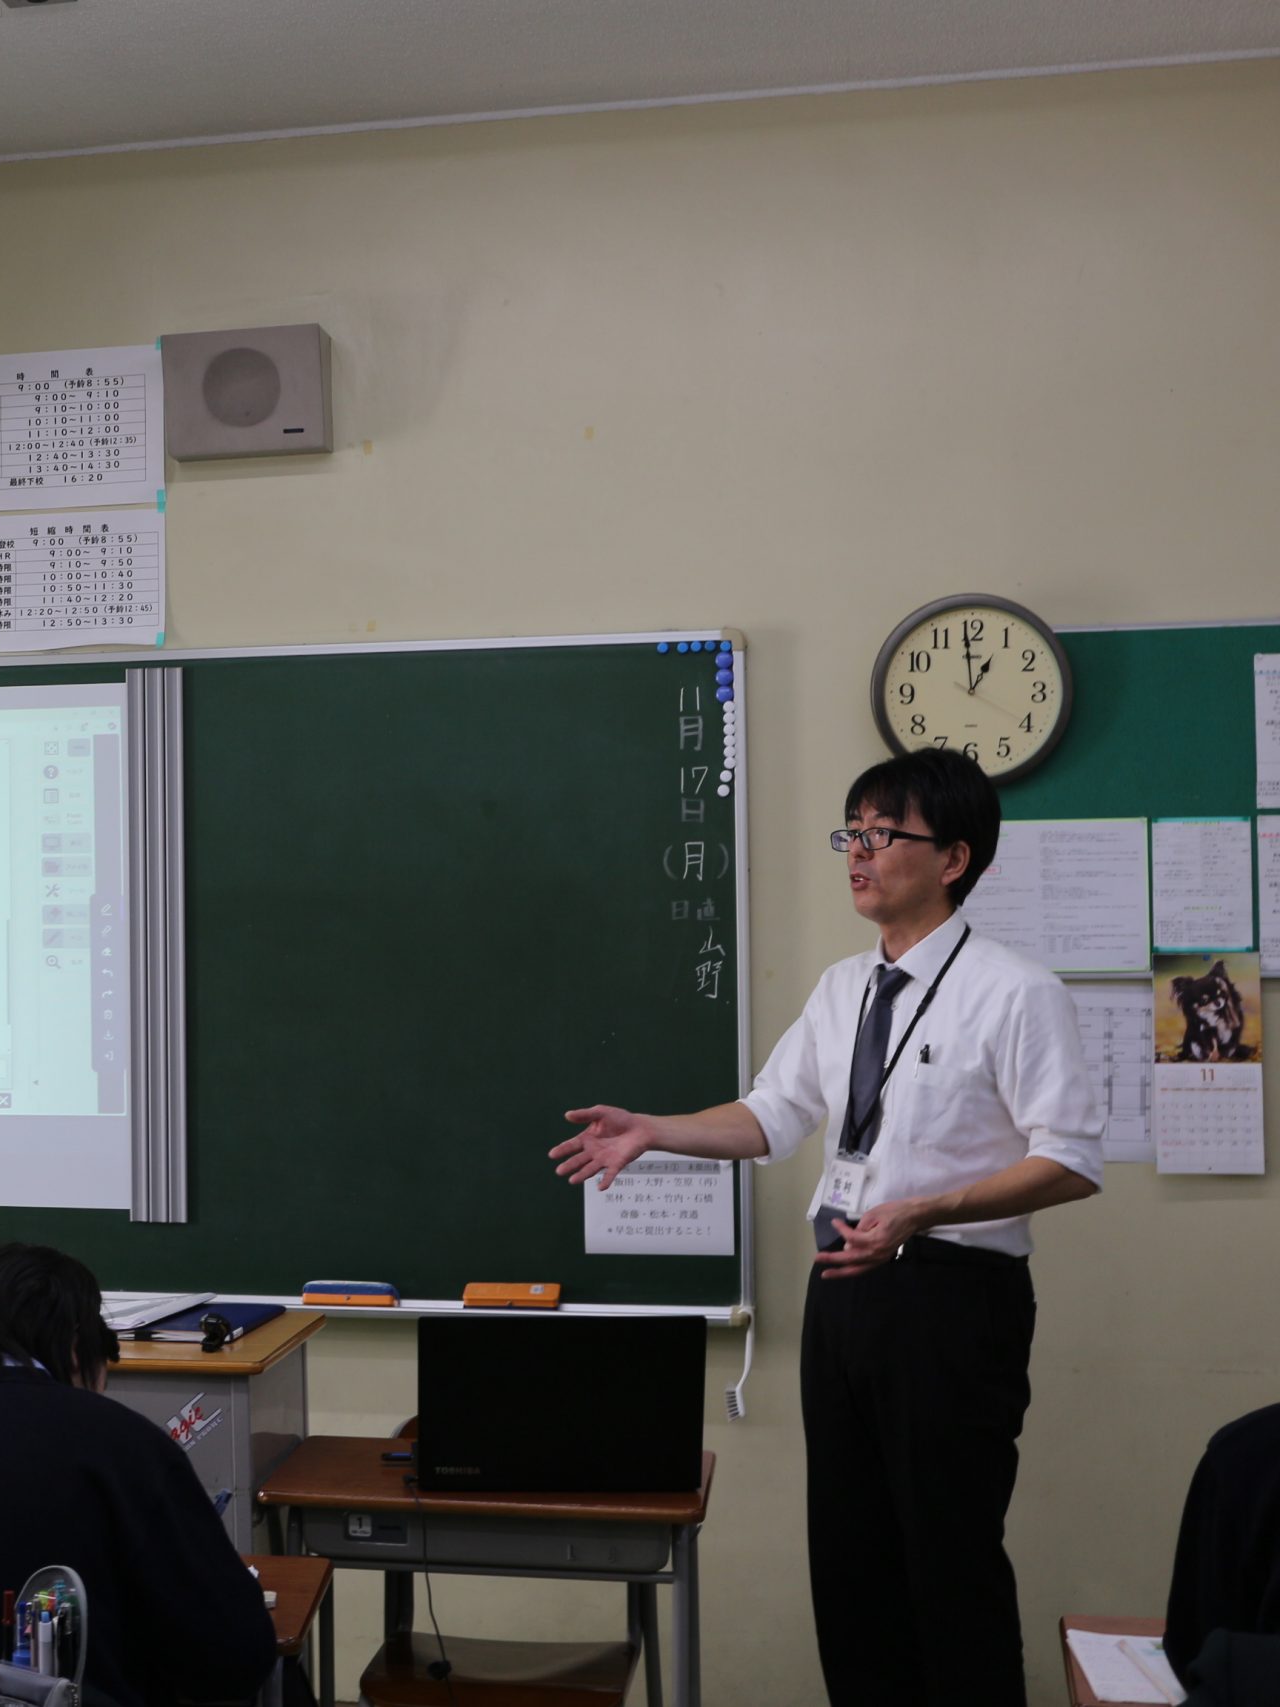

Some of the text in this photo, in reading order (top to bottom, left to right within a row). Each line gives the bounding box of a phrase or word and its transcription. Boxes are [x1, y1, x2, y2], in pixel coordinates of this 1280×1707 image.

[932, 628, 950, 649] 11
[961, 620, 984, 642] 12
[1002, 628, 1010, 648] 1
[908, 651, 931, 673] 10
[1021, 650, 1035, 672] 2
[899, 683, 915, 705] 9
[1031, 681, 1047, 703] 3
[910, 714, 926, 736] 8
[1019, 712, 1034, 733] 4
[963, 742, 978, 764] 6
[996, 737, 1011, 757] 5
[671, 898, 720, 922] 日直
[1200, 1069, 1215, 1082] 11
[435, 1466, 481, 1475] TOSHIBA
[357, 1516, 363, 1530] 1
